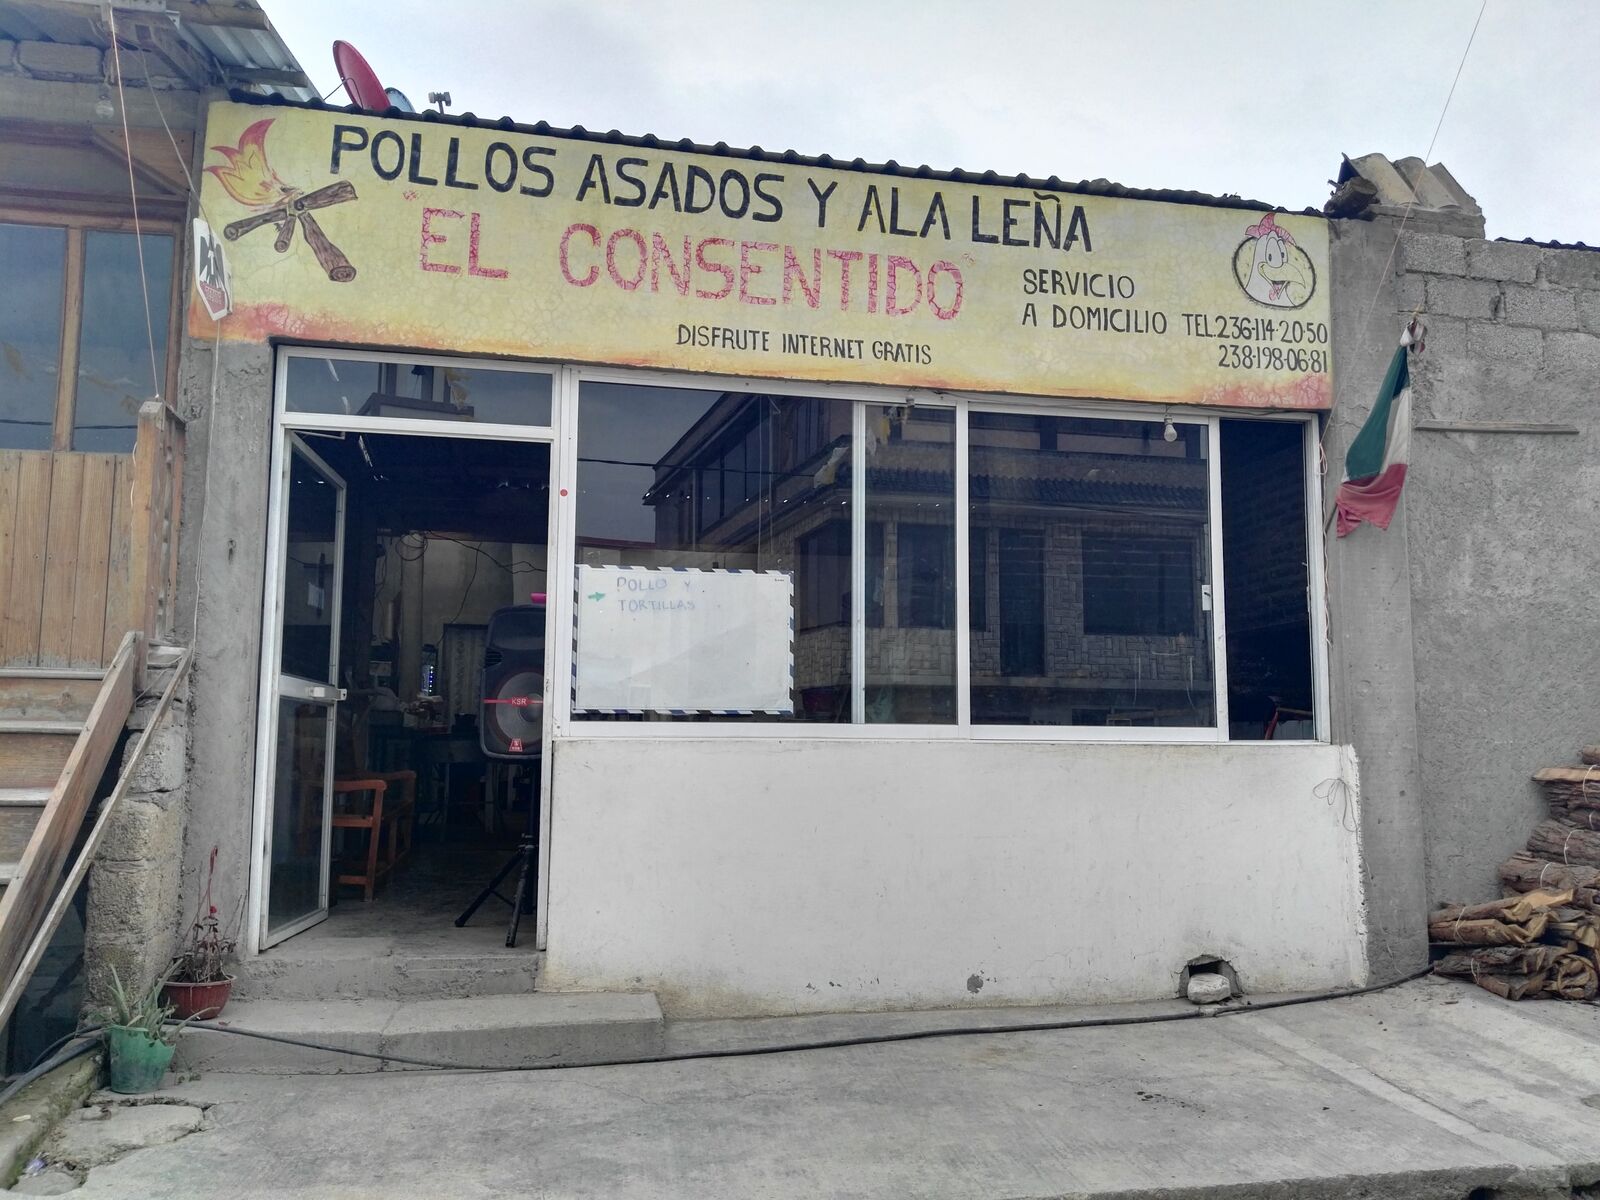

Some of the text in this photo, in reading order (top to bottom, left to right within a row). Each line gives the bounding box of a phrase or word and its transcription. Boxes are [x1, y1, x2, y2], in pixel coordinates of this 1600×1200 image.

[329, 124, 557, 199] POLLOS
[575, 153, 786, 223] ASADOS
[807, 177, 838, 228] Y
[971, 190, 1093, 252] LEÑA
[1023, 269, 1135, 299] SERVICIO
[1022, 303, 1037, 327] A
[1052, 304, 1167, 335] DOMICILIO
[676, 324, 932, 365] DISFRUTE INTERNET GRATIS
[616, 576, 667, 592] POLLO
[619, 599, 695, 613] TORTILLAS
